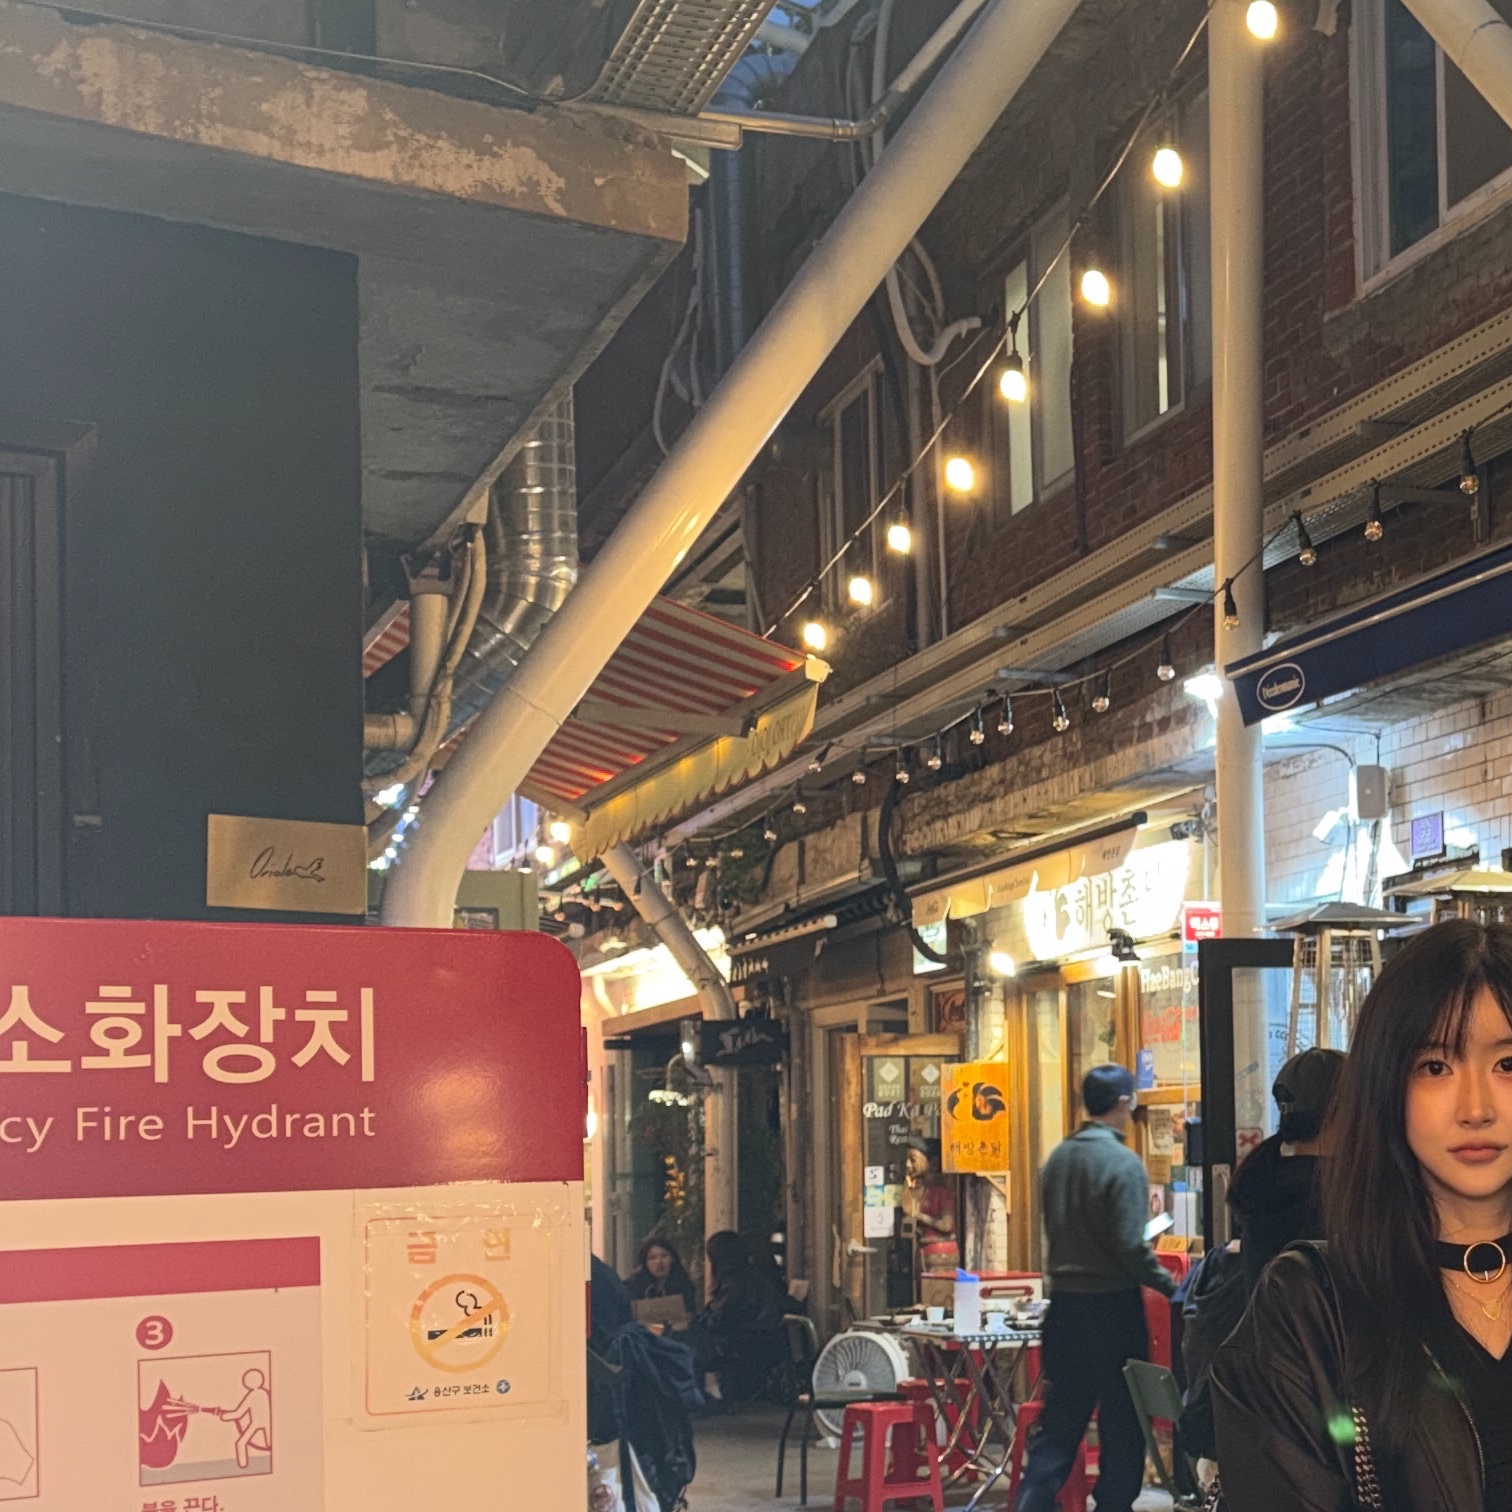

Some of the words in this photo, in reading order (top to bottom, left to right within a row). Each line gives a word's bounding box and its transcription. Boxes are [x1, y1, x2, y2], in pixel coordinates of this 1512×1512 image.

[863, 1100, 897, 1118] Pad
[76, 1107, 165, 1142] Fire
[186, 1104, 377, 1150] Hydrant
[145, 1320, 164, 1346] 3
[433, 1386, 461, 1397] 용산구
